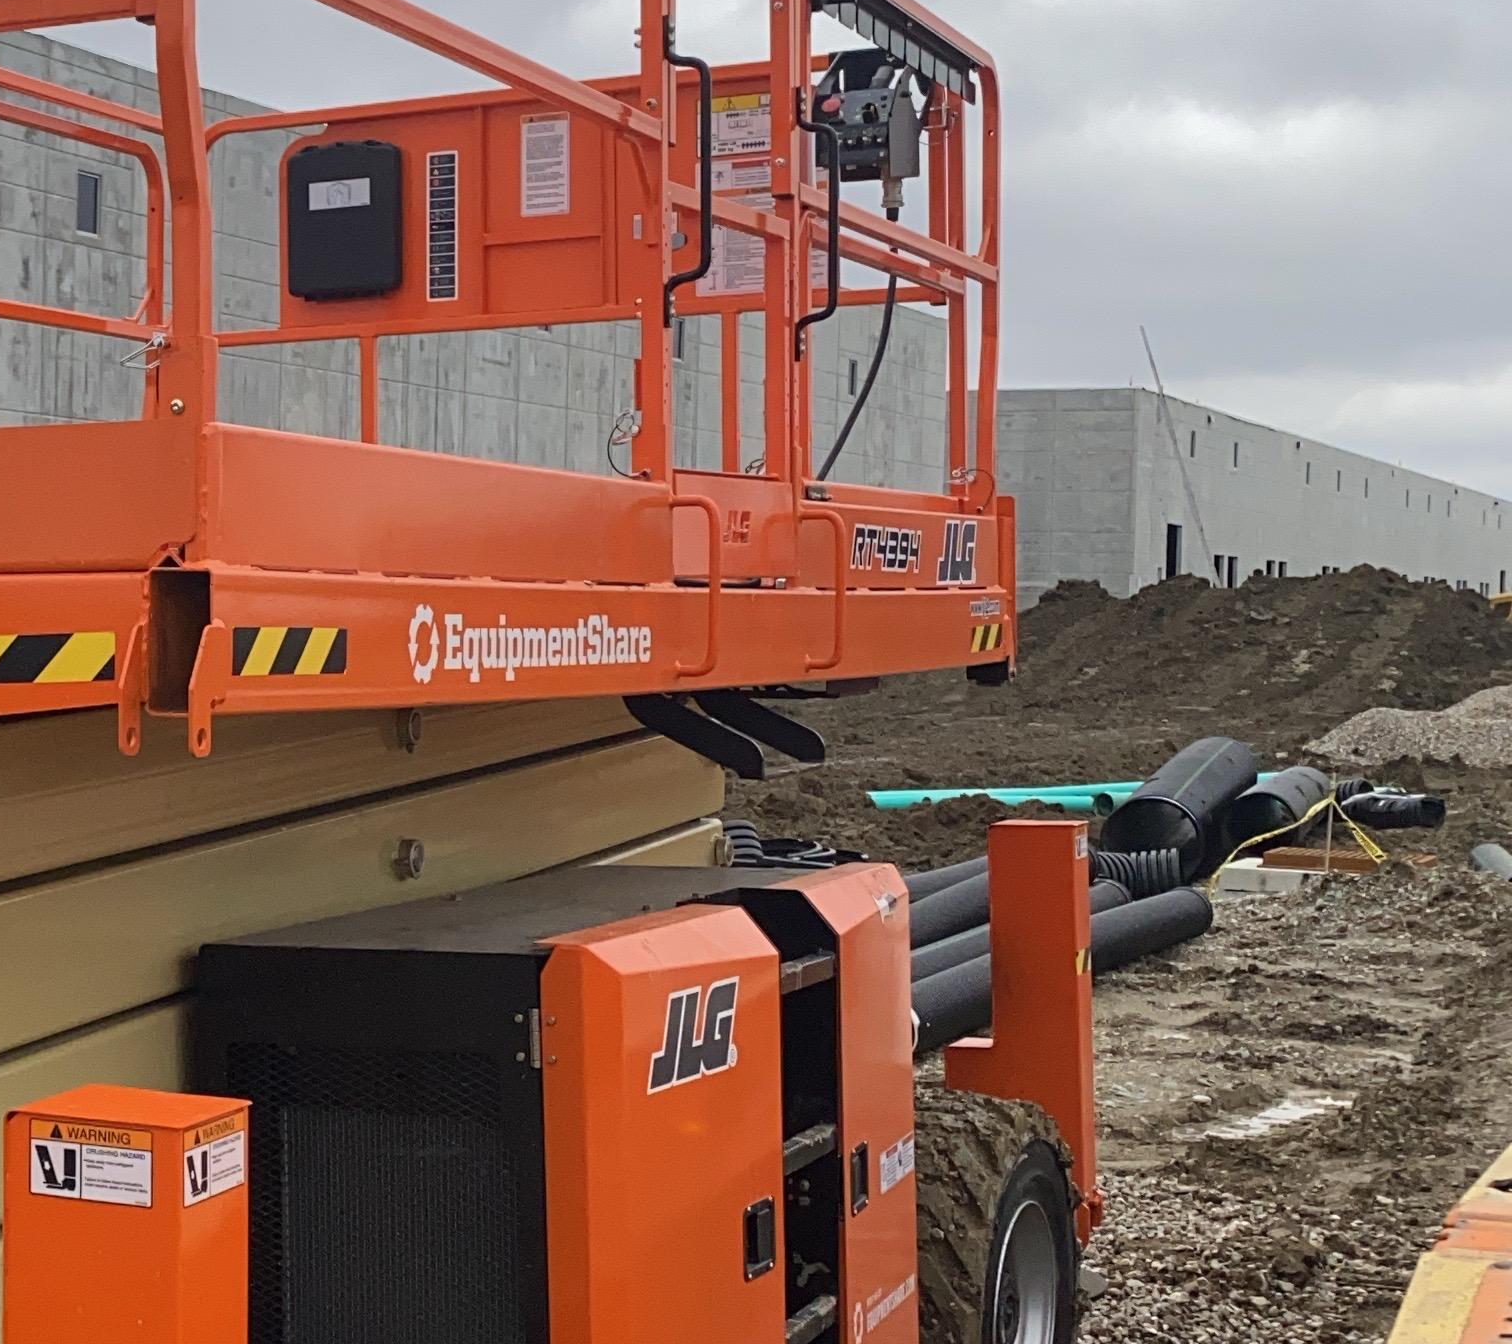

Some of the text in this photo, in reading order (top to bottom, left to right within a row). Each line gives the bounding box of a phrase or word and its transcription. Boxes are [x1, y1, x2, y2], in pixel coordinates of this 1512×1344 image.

[850, 519, 978, 585] RT4394 JLG
[443, 613, 652, 683] EquipmentShare
[647, 976, 740, 1096] JLG
[67, 1126, 131, 1145] WARNING
